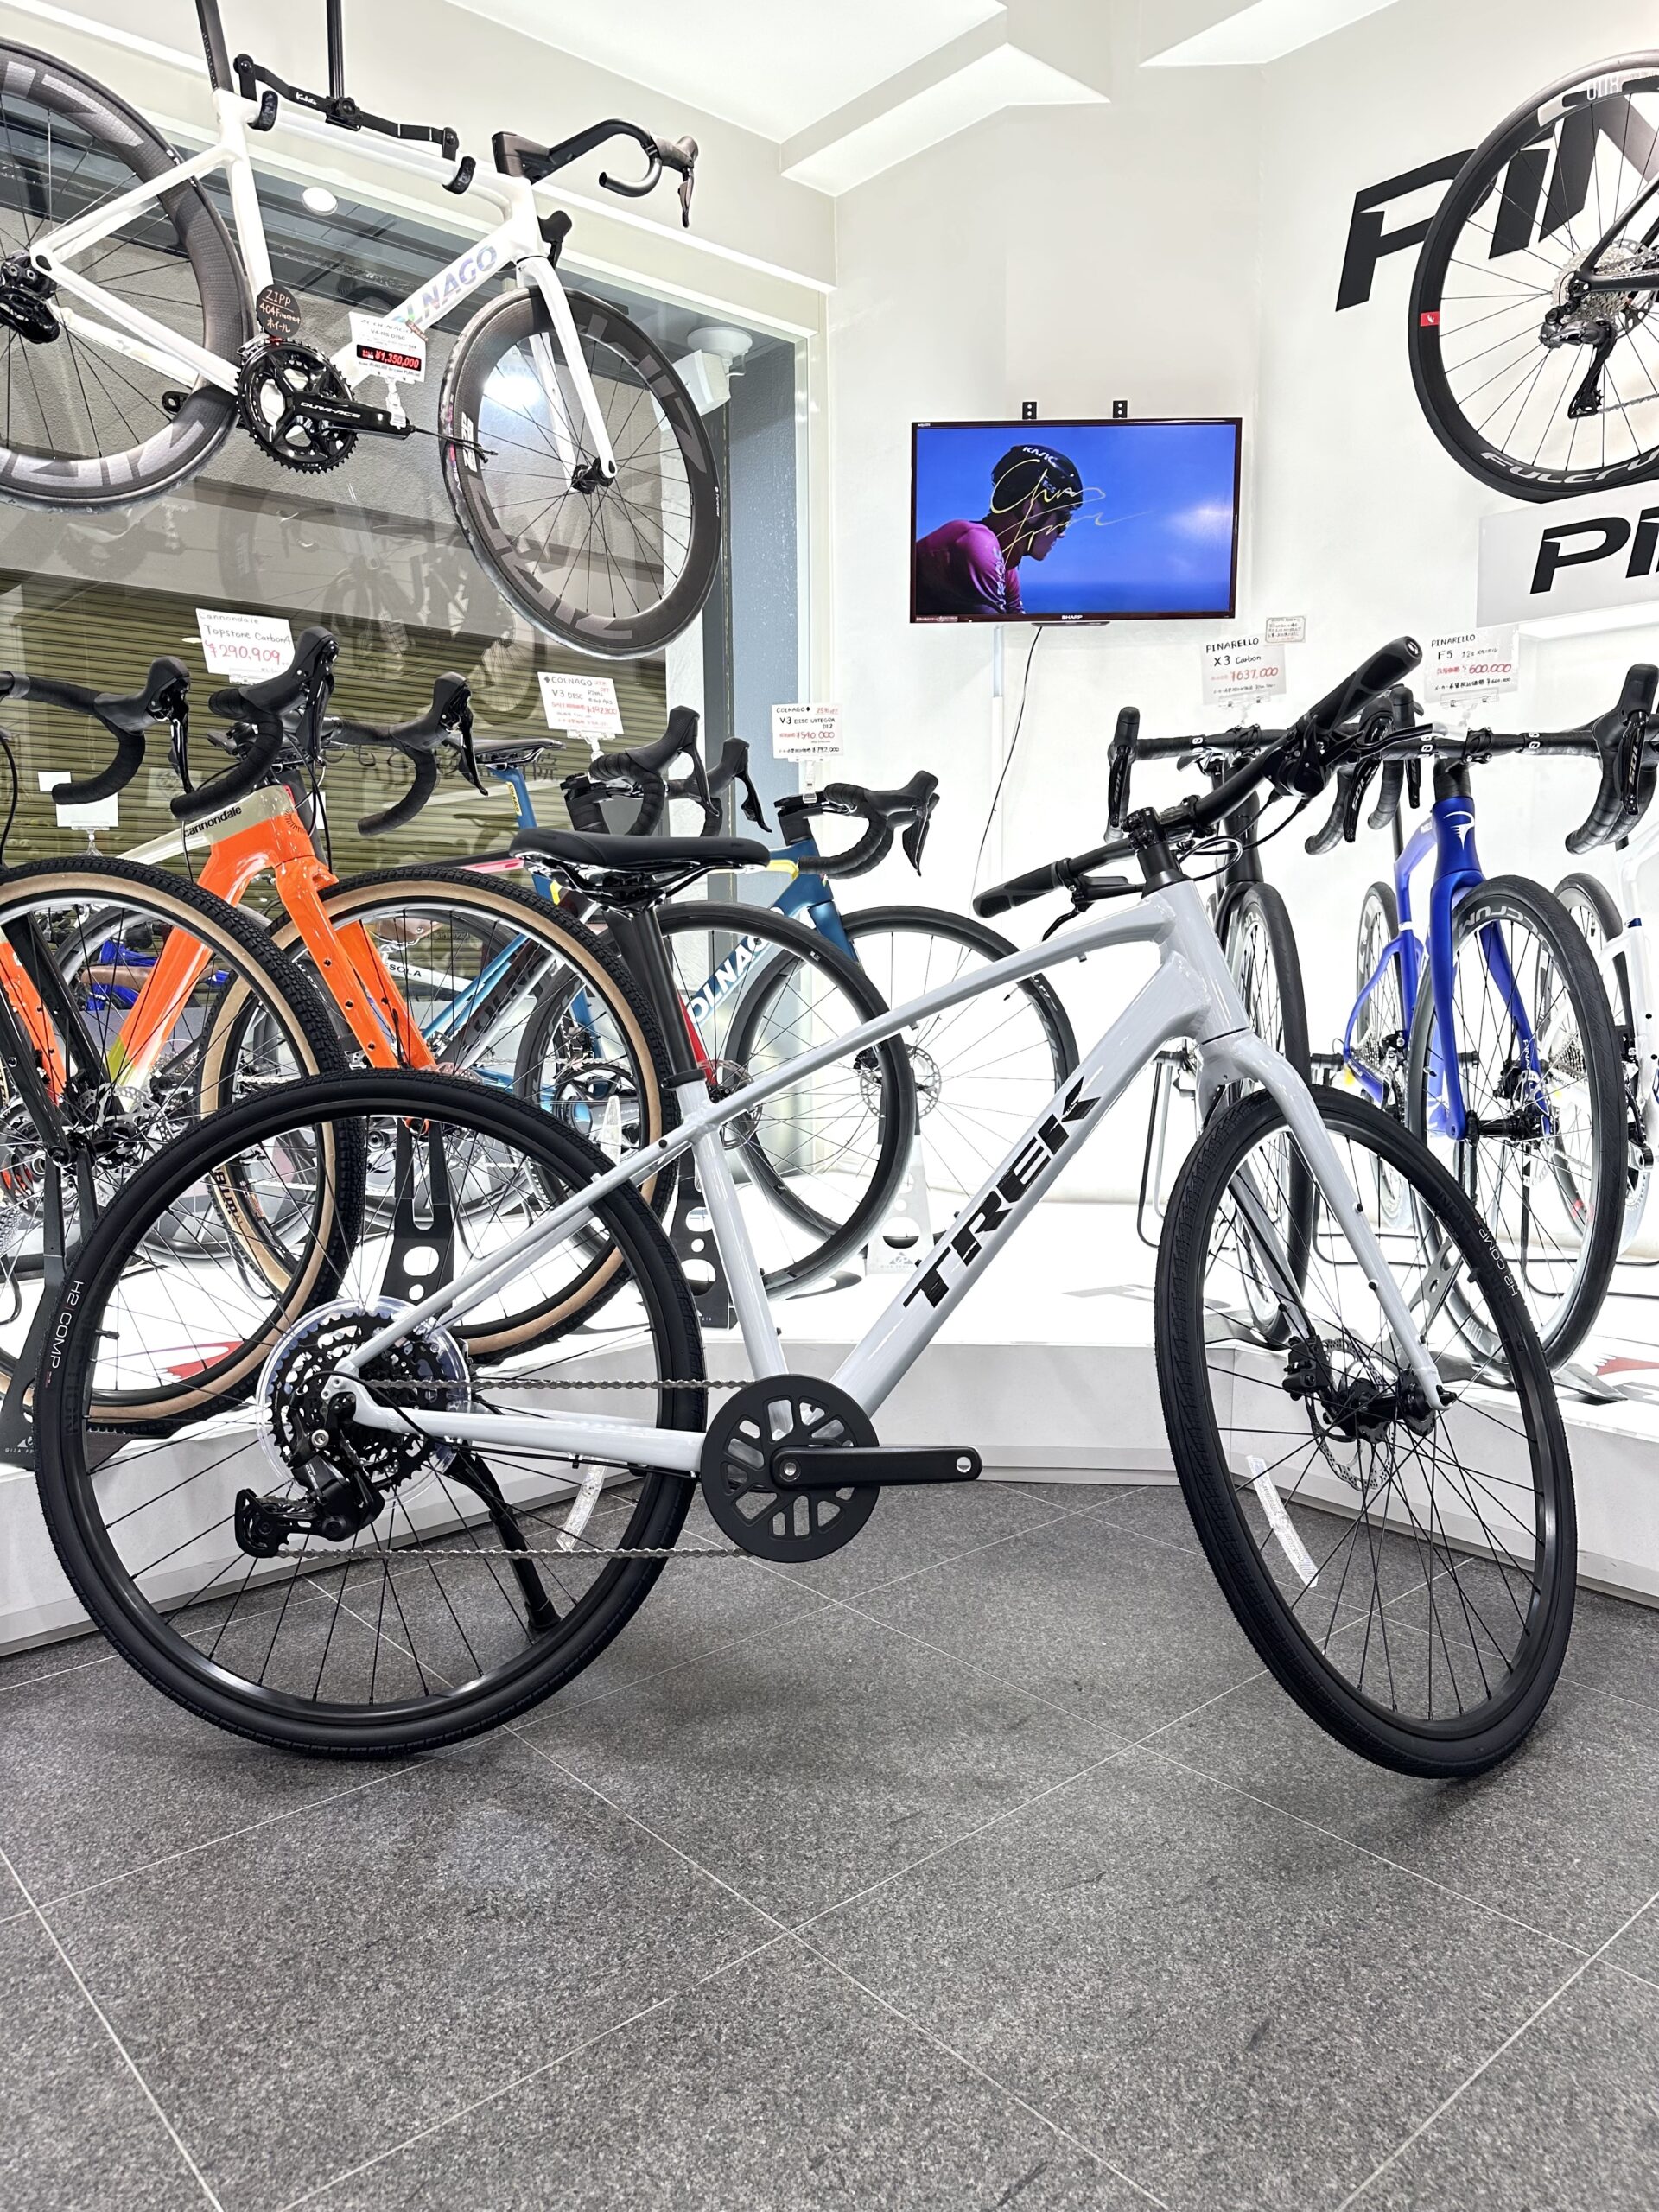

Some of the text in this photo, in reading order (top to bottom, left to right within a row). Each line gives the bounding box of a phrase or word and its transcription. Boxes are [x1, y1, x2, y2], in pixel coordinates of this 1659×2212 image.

[391, 245, 498, 325] LNAGO
[265, 289, 291, 307] ZIPP
[267, 316, 291, 333] ホイール
[375, 350, 420, 369] ¥1,350,000
[300, 402, 361, 418] DURA-ACE
[199, 612, 260, 624] Cannondale
[203, 624, 251, 639] Topstone
[1205, 637, 1260, 654] PINARELLO
[1431, 633, 1476, 648] PINARELLO
[1213, 655, 1262, 667] X3 Carbon
[1438, 650, 1453, 660] F5
[551, 676, 593, 687] COLNAGO
[551, 689, 565, 698] V3
[779, 716, 792, 725] V3
[184, 806, 242, 837] cannondale
[903, 1075, 1101, 1308] TREK
[1478, 1228, 1505, 1270] COMP
[50, 1280, 85, 1369] H2 COMP
